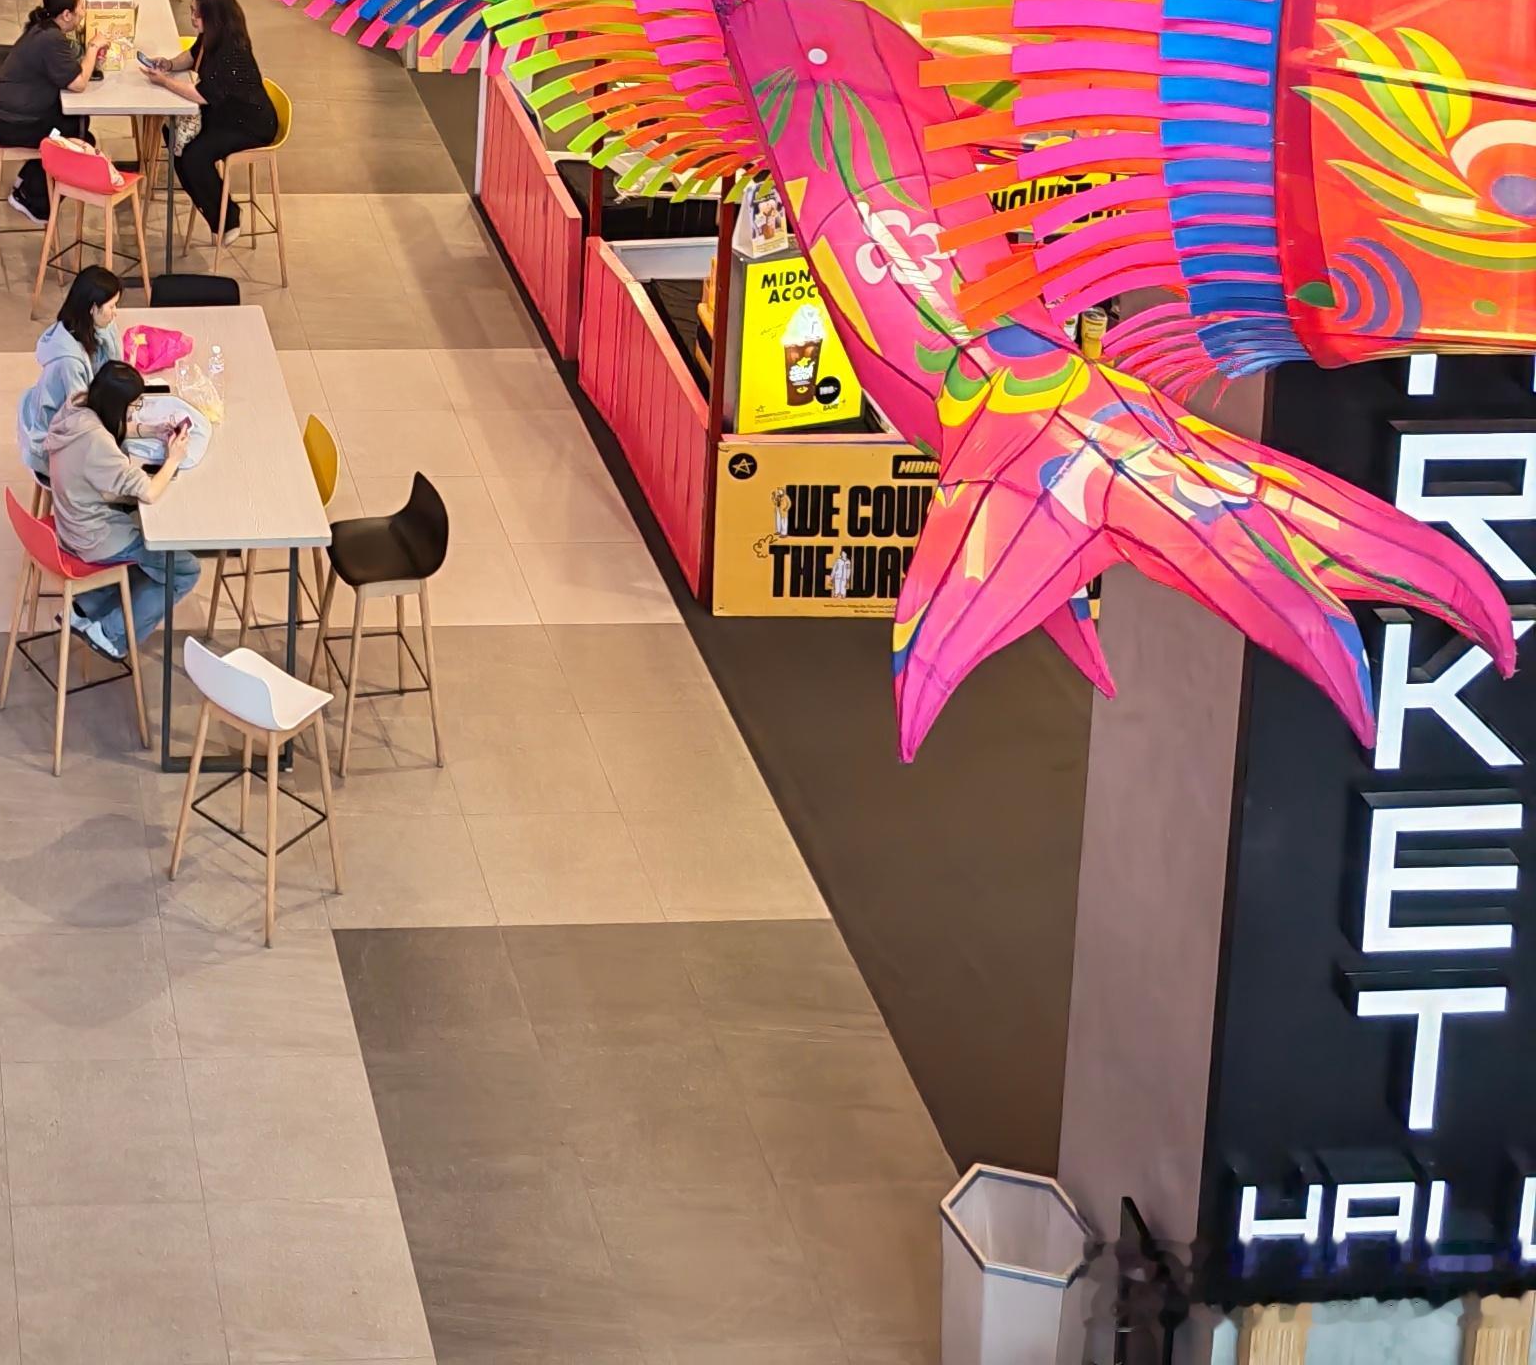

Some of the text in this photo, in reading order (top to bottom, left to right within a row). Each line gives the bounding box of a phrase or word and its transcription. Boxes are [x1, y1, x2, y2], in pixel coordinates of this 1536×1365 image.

[786, 484, 841, 538] WE
[768, 544, 834, 598] THE
[1357, 354, 1536, 1130] RKET
